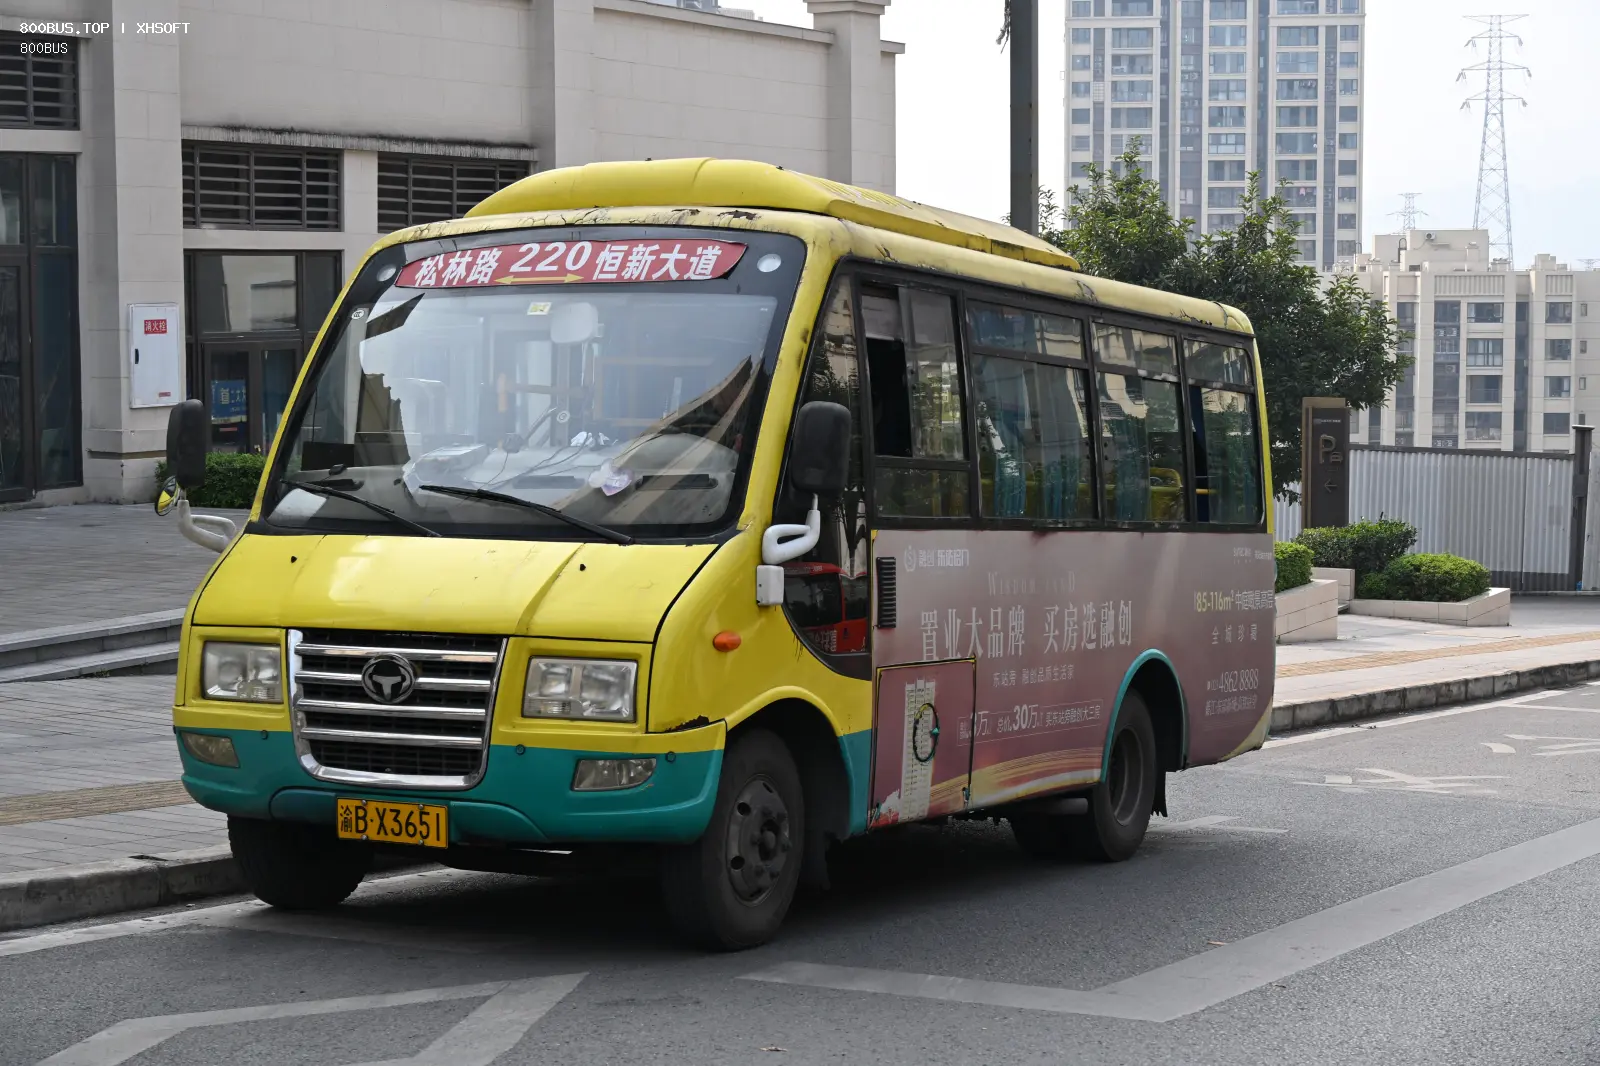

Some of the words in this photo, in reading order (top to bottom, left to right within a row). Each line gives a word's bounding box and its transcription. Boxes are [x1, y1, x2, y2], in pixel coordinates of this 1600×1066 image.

[414, 248, 502, 287] 松林路
[509, 241, 593, 273] 220
[592, 244, 723, 281] 恒新大道
[144, 321, 168, 332] 消火栓
[920, 605, 1026, 662] 置业大品牌
[1043, 599, 1132, 654] 买房选融创
